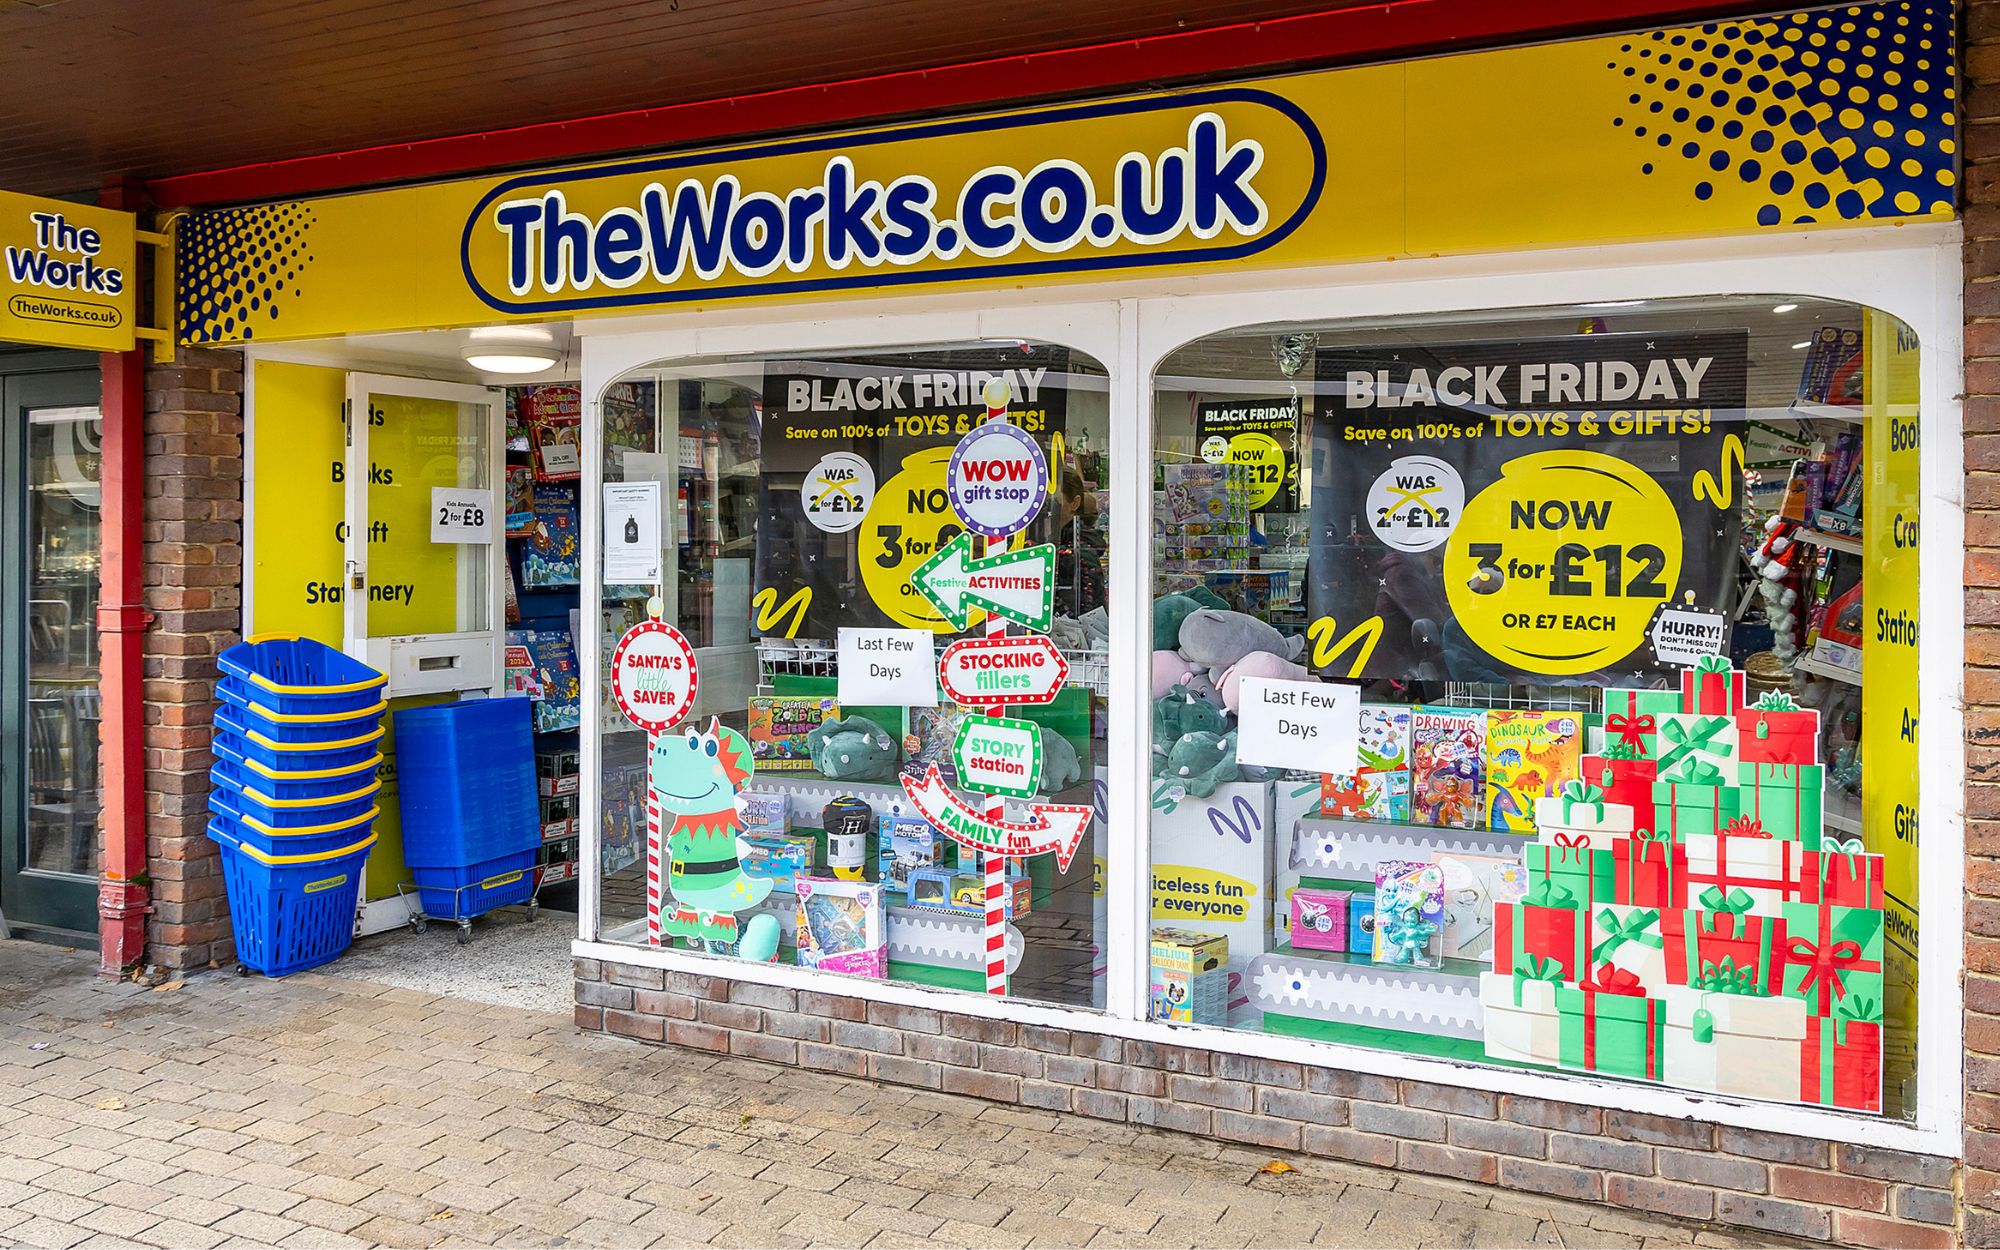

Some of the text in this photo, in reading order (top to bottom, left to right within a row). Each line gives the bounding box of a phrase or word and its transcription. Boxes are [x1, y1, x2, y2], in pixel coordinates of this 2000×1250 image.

[495, 111, 1265, 297] TheWorks.co.uk
[30, 212, 101, 256] The
[5, 245, 123, 296] Works
[15, 300, 116, 323] TheWorks.co.uk
[1897, 326, 1920, 354] Kid
[1345, 357, 1713, 409] BLACK FRIDAY
[787, 375, 907, 413] BLACK
[1205, 406, 1295, 422] BLACK FRIDAY
[785, 410, 1046, 440] Save on 100's of TOYS & GTS!
[1242, 422, 1262, 431] TOYS
[1344, 408, 1711, 442] Save on 100's of TOYS & GIFTS!
[1891, 411, 1920, 452] Boo
[1233, 450, 1264, 461] NOW
[1778, 444, 1812, 457] ACTIVI
[332, 461, 393, 485] Bks
[824, 468, 854, 481] WAS
[962, 459, 1032, 482] WOW
[1395, 475, 1436, 490] WAS
[809, 495, 864, 512] 2 for £12
[907, 488, 949, 514] NO
[964, 485, 1030, 504] gift stop
[439, 508, 484, 527] 2 for £8
[1376, 507, 1450, 529] 2 for £12
[1510, 499, 1612, 531] NOW
[1833, 520, 1846, 531] X8
[335, 521, 389, 543] Cft
[1894, 513, 1920, 548] Cra
[875, 525, 904, 569] 3
[905, 537, 931, 555] for
[1467, 542, 1667, 598] 3 for £12
[306, 581, 414, 606] Stanery
[929, 575, 1041, 591] Festive ACTIVITIES
[1502, 613, 1616, 632] OR £7 EACH
[1662, 620, 1720, 640] HURRY!
[1877, 608, 1919, 648] Statio
[857, 636, 914, 652] Last Few
[1659, 644, 1688, 653] In-store
[1660, 636, 1685, 645] DON'T
[1686, 639, 1703, 647] MISS
[627, 653, 682, 671] SANTA'S
[870, 663, 902, 681] Days
[960, 652, 1045, 671] STOCKING
[635, 665, 672, 693] little
[976, 671, 1031, 690] fillers
[633, 689, 676, 706] SAVER
[1264, 687, 1336, 710] Last Few
[773, 708, 821, 723] ZOMBIE
[1416, 715, 1476, 731] DRAWING
[1901, 707, 1919, 743] Ar
[1278, 719, 1318, 741] Days
[1490, 723, 1546, 739] DINOSAUR
[970, 737, 1025, 759] STORY
[970, 757, 1024, 776] station
[939, 806, 1032, 849] FAMILY fun
[1894, 803, 1919, 849] Gif
[1152, 877, 1243, 898] iceless fun
[1163, 898, 1244, 917] everyone
[1152, 946, 1190, 961] HELIUM
